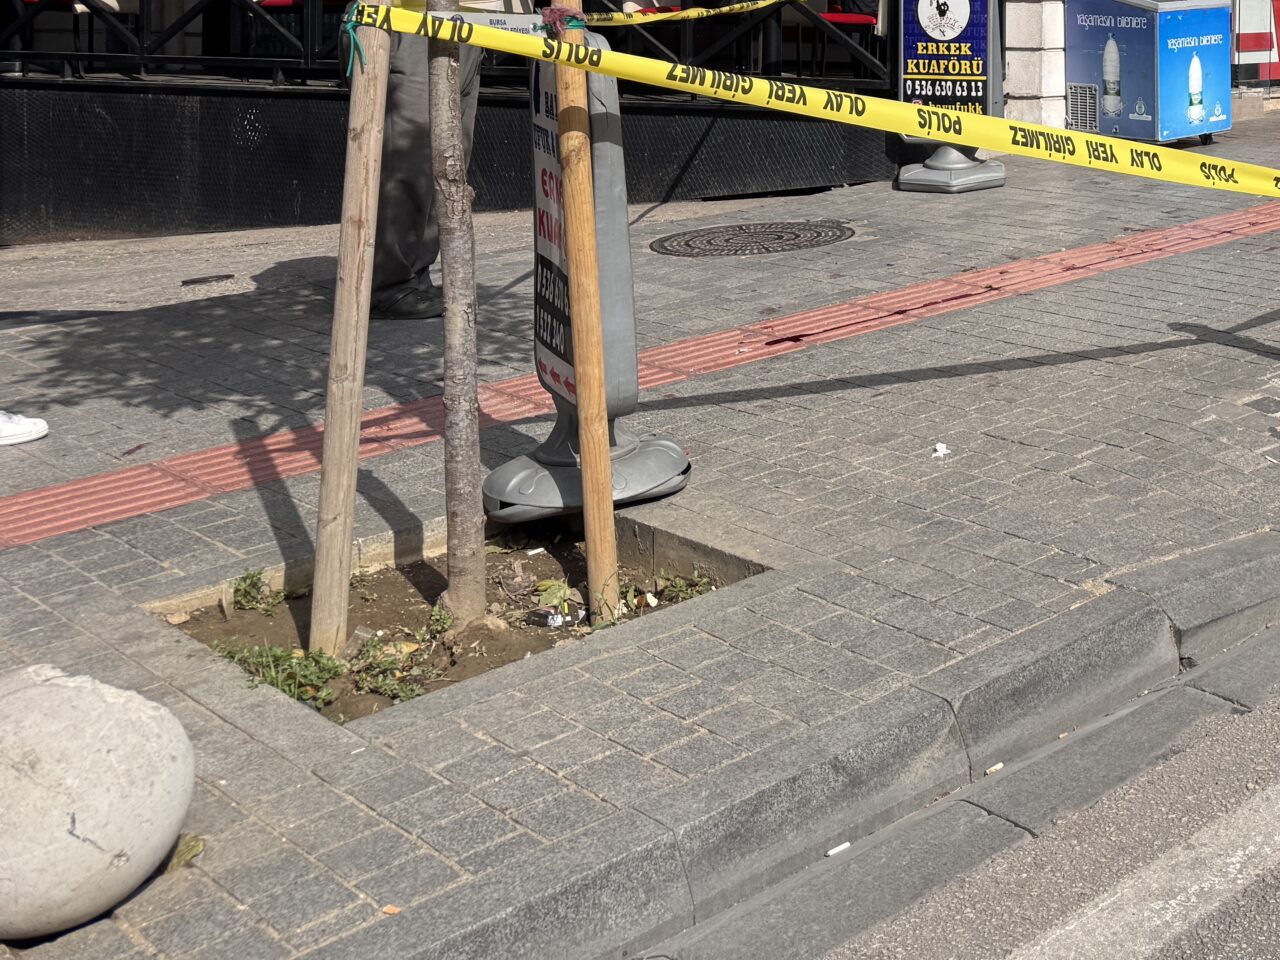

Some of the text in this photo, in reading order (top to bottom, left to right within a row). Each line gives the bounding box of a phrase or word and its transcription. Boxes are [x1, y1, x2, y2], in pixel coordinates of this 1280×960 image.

[415, 13, 474, 43] OLAY
[542, 37, 602, 67] POLİS
[917, 42, 972, 55] ERKEK
[907, 57, 984, 74] KUAFÖRÜ
[666, 62, 963, 135] POLİS OLAY YERİ GİRİLMEZ
[906, 80, 983, 96] 0 536 630 63 13
[1009, 125, 1239, 187] POLİS OLAY YERİ GİRİLMEZ
